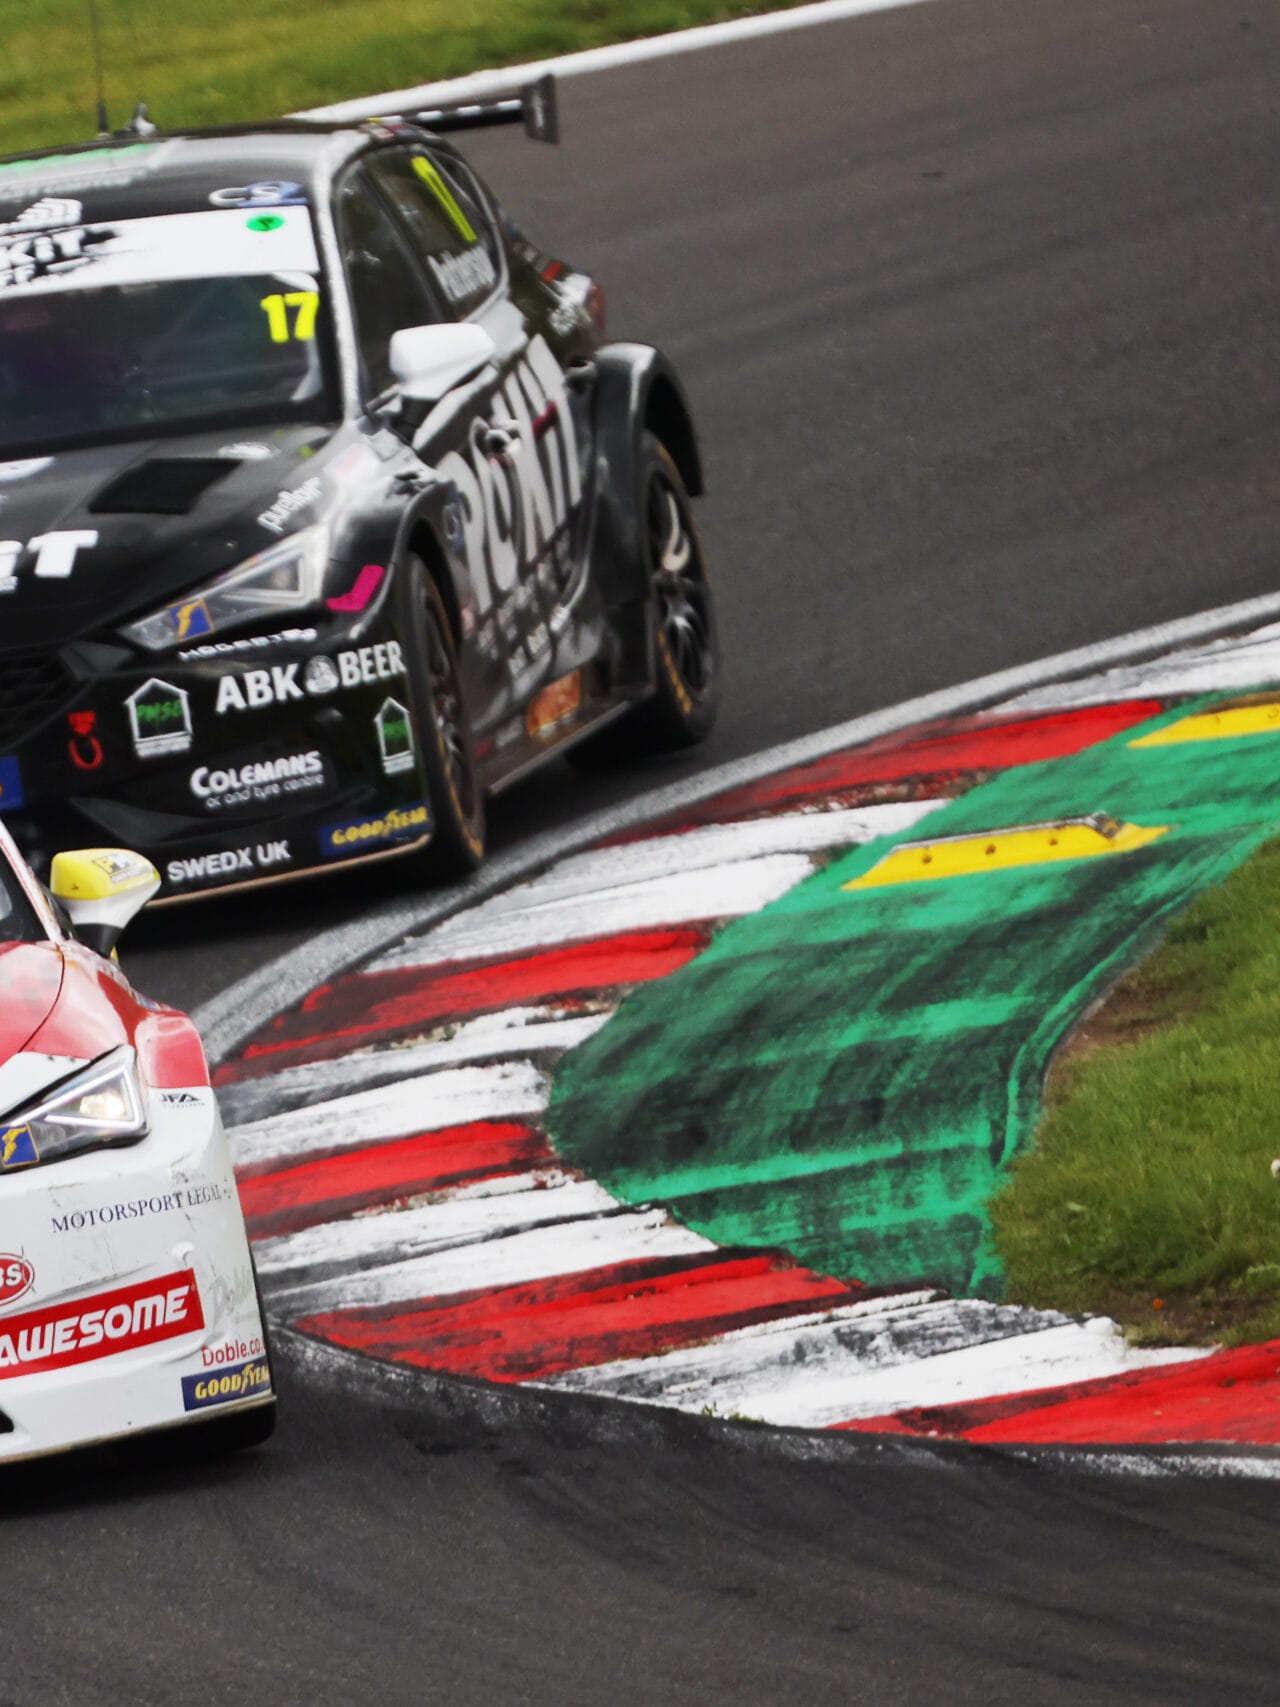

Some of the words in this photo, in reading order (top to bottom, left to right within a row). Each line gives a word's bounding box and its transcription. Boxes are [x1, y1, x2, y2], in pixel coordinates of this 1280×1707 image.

[260, 291, 319, 343] 17
[216, 662, 304, 714] ABK
[337, 639, 408, 688] BEER
[331, 806, 429, 846] GOODYEAR
[166, 847, 254, 883] SWEDX
[256, 840, 292, 865] UK
[51, 1192, 185, 1234] MOTORSPORT
[183, 1184, 224, 1207] LEGAL
[195, 1362, 270, 1400] GOODYEA
